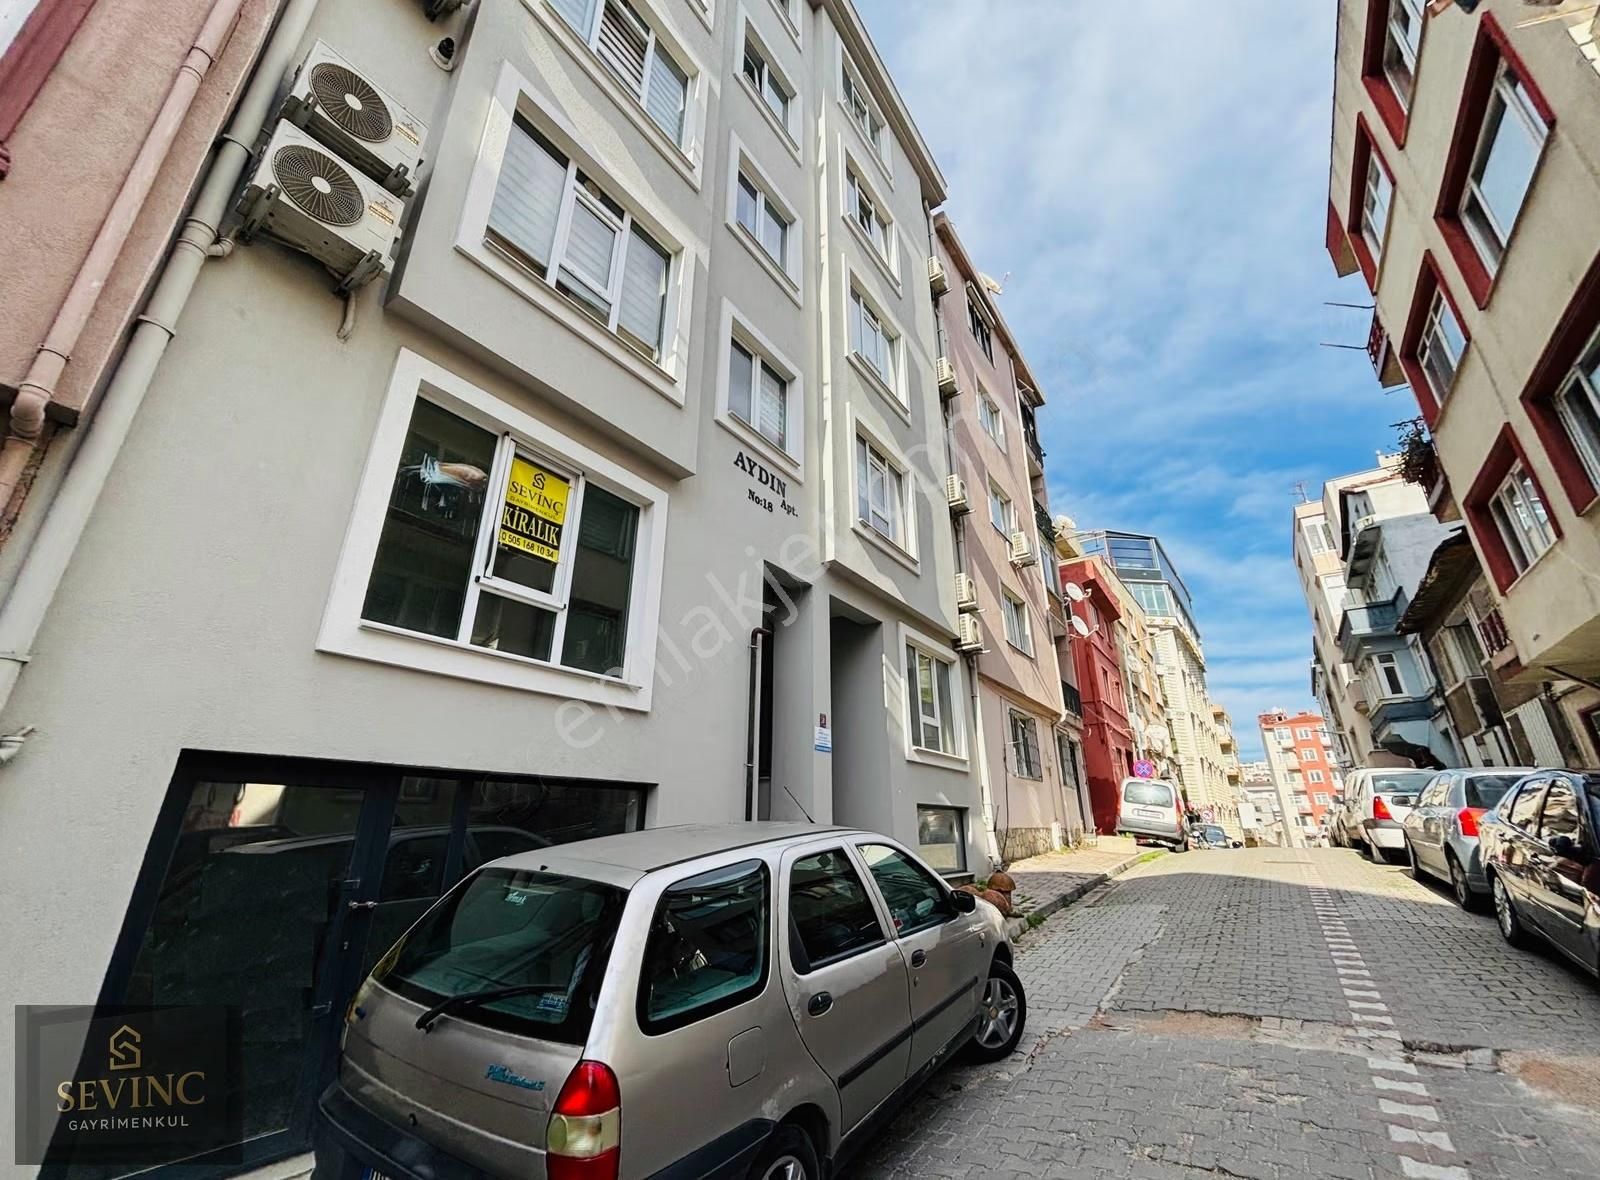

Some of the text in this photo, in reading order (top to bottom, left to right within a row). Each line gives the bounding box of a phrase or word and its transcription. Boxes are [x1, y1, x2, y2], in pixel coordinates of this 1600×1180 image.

[733, 451, 787, 498] AYDIN
[509, 481, 564, 516] SEVİNÇ
[747, 488, 774, 513] No:18
[780, 499, 799, 518] Apt.
[502, 505, 560, 546] KİRALIK
[509, 534, 521, 546] 505
[523, 540, 535, 551] 168
[537, 546, 545, 555] 10
[546, 550, 554, 559] 34
